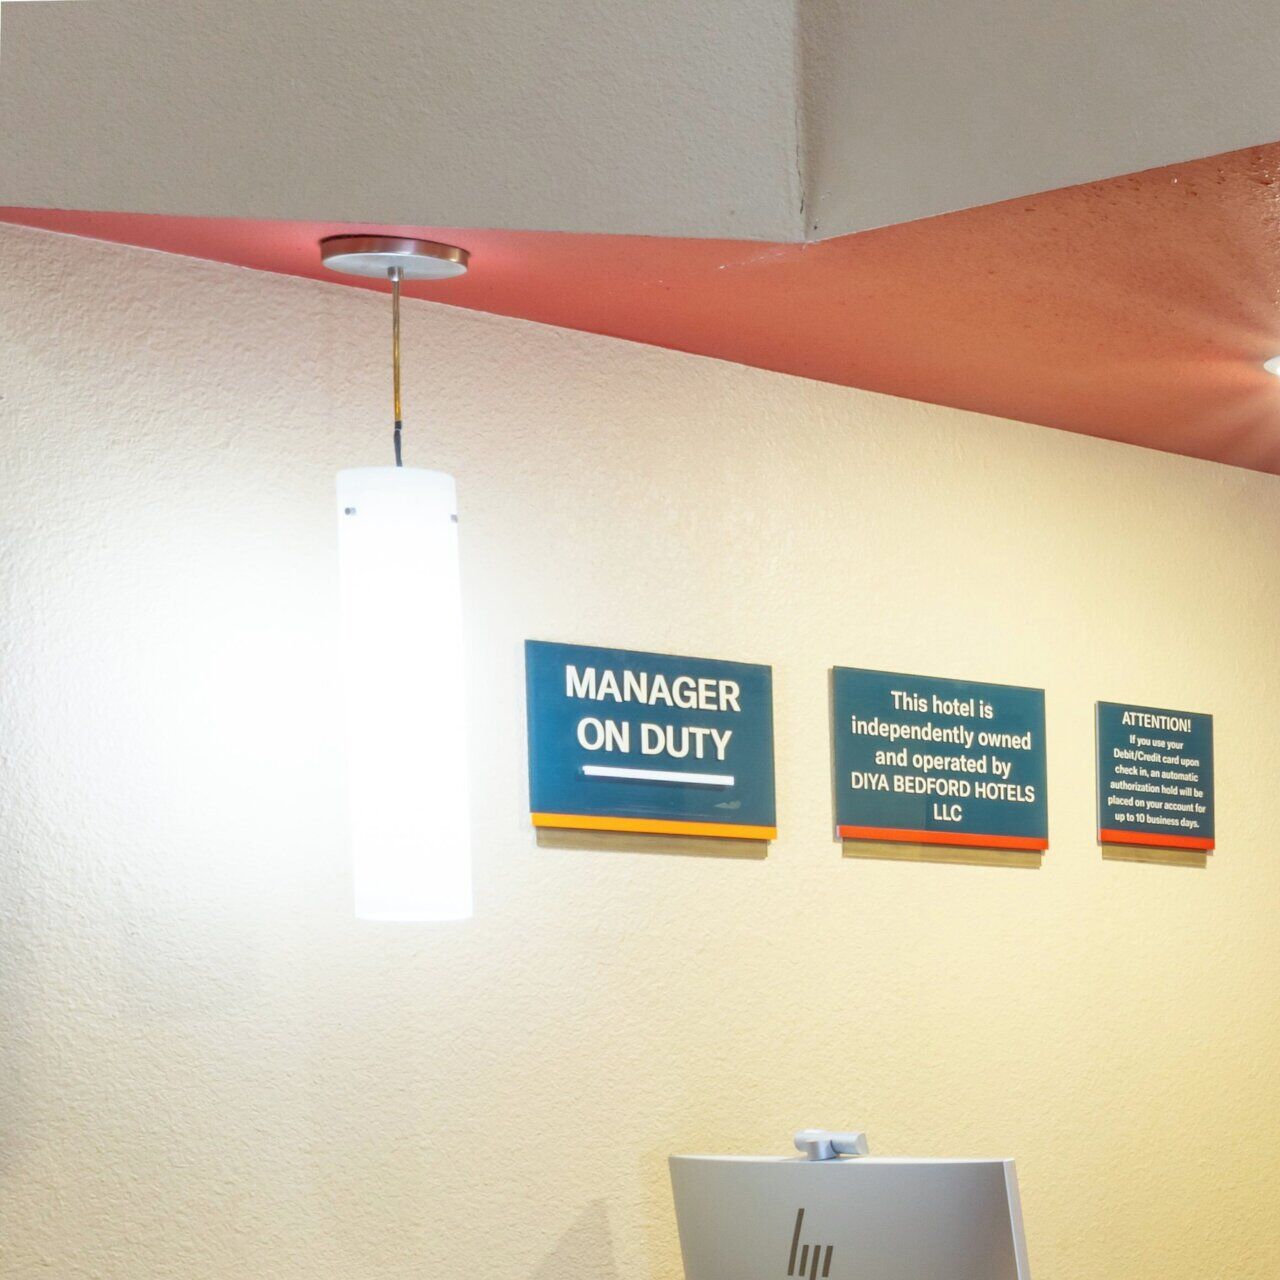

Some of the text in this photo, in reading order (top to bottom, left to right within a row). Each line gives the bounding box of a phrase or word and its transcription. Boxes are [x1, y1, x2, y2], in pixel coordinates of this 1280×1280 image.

[565, 665, 741, 712] MANAGER
[891, 690, 994, 719] This hotel is
[851, 715, 1031, 750] independently owned
[1121, 711, 1191, 733] ATTENTION!
[577, 717, 733, 760] ON DUTY
[1129, 734, 1184, 750] If you use your
[875, 748, 1011, 779] and operated by
[1113, 748, 1200, 768] Debit/Credit card upon
[1114, 764, 1199, 782] check in, an automatic
[851, 771, 1035, 802] DIYA BEDFORD HOTELS
[1110, 780, 1203, 798] authorization hold will be
[933, 803, 963, 822] LLC
[1107, 795, 1207, 813] placed on your account for
[1114, 813, 1200, 829] up to 10 business days.
